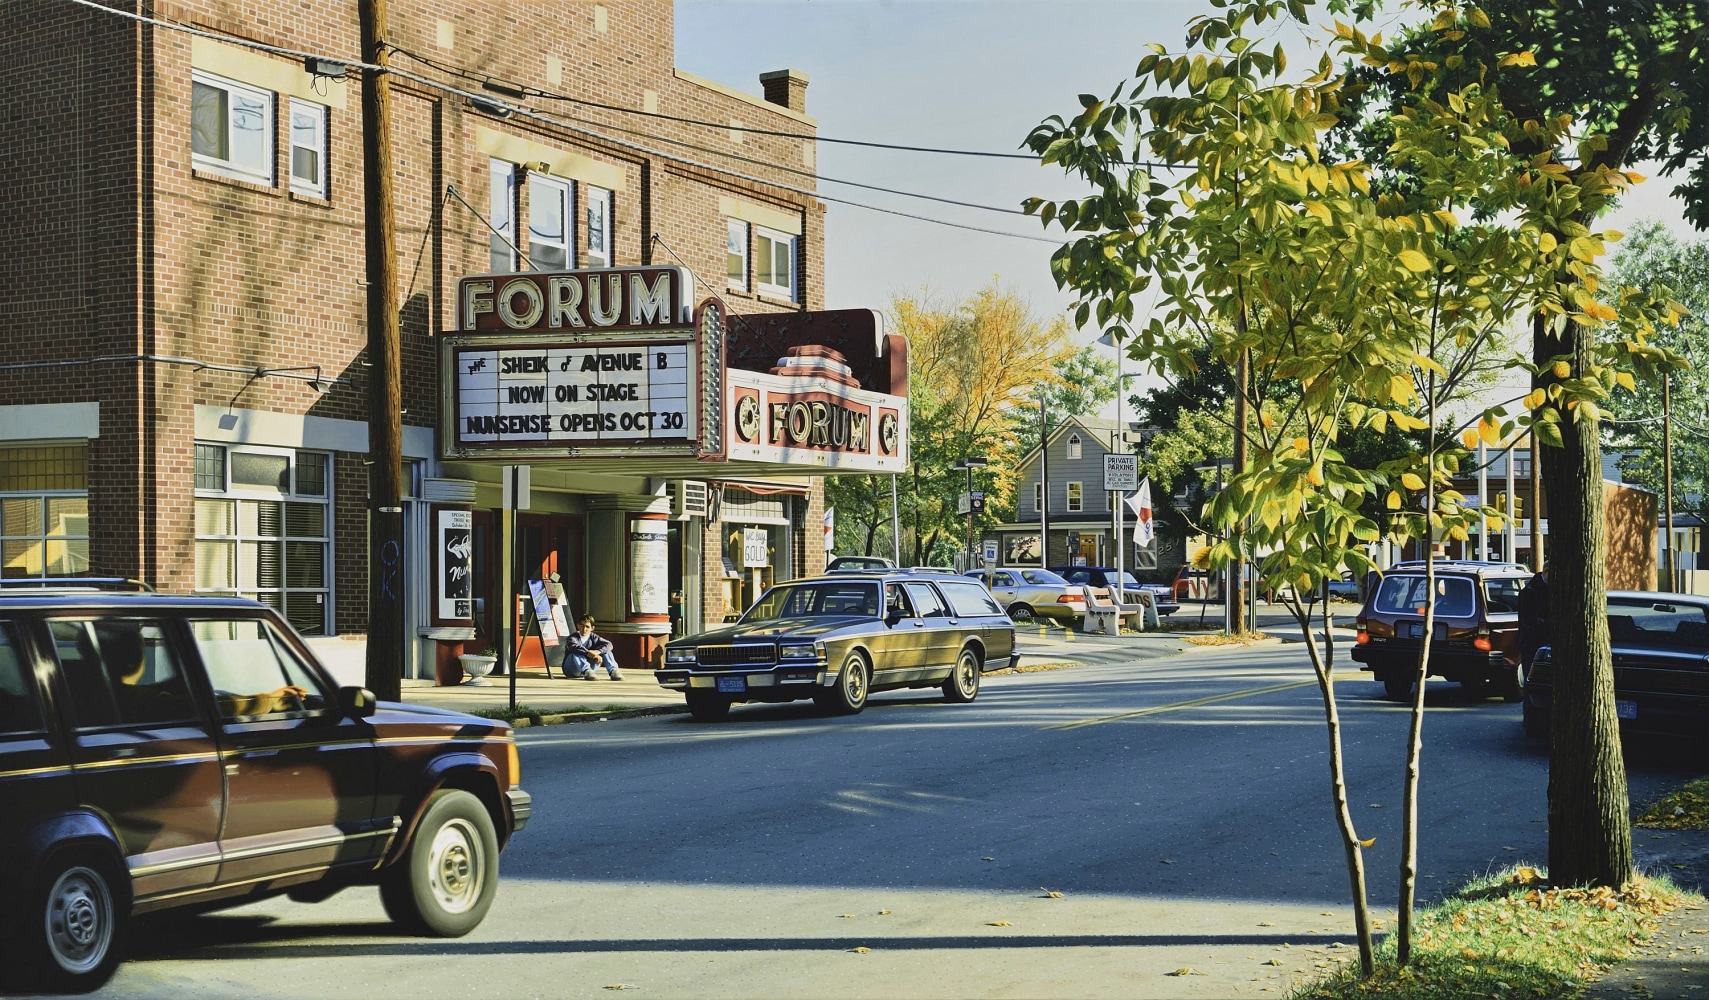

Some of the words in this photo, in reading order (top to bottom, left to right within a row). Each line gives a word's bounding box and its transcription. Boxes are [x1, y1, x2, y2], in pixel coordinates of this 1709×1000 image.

[464, 272, 670, 331] FORUM
[468, 358, 486, 375] THE
[501, 356, 550, 374] SHEIK
[560, 355, 573, 372] OF
[580, 353, 643, 372] AVENUE
[656, 352, 668, 370] B
[508, 386, 545, 404] NOW
[555, 385, 578, 402] ON
[586, 383, 639, 402] STAGE
[466, 415, 552, 435] NUNSENSE
[560, 412, 617, 432] OPENS
[619, 411, 656, 430] OCT
[661, 411, 684, 430] 30
[769, 401, 869, 451] FORUM
[1107, 457, 1134, 465] PRIVATE
[744, 545, 766, 562] GOLD
